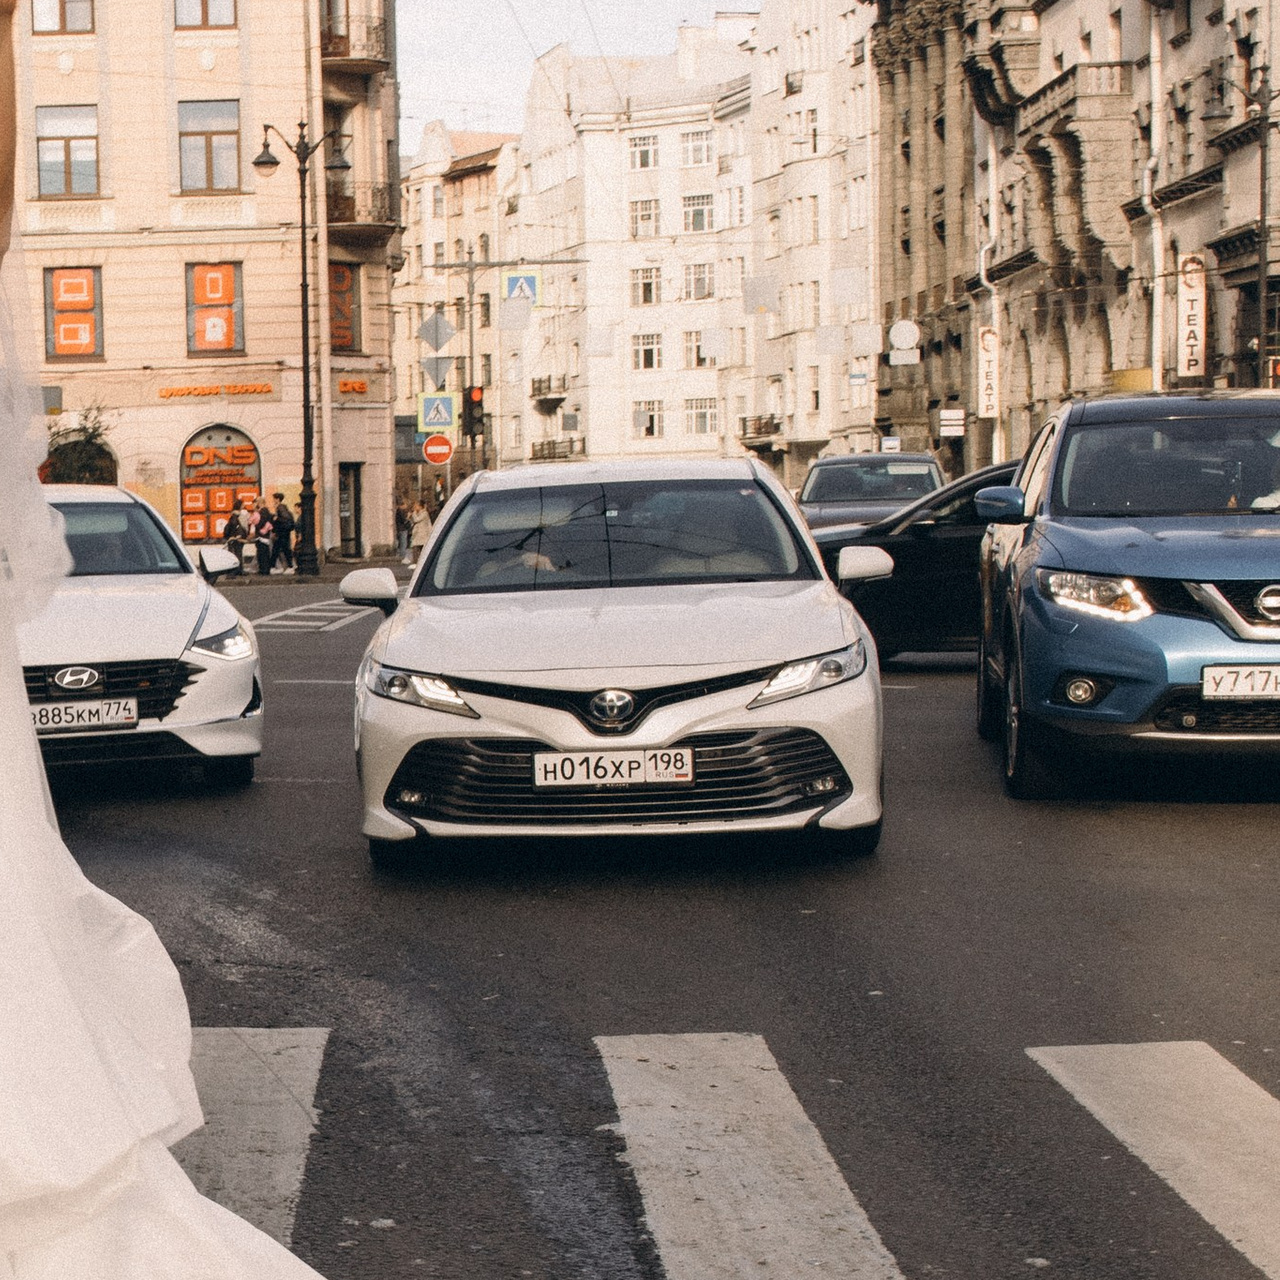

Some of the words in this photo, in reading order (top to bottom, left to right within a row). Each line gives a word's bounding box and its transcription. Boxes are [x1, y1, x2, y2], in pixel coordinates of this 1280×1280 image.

[1186, 299, 1199, 372] ТЕАТР
[985, 360, 995, 413] ТЕАТР
[185, 445, 256, 466] DNS
[104, 701, 131, 716] 774
[543, 756, 641, 781] Н016ХР
[648, 752, 685, 771] 198
[655, 771, 674, 779] RUS
